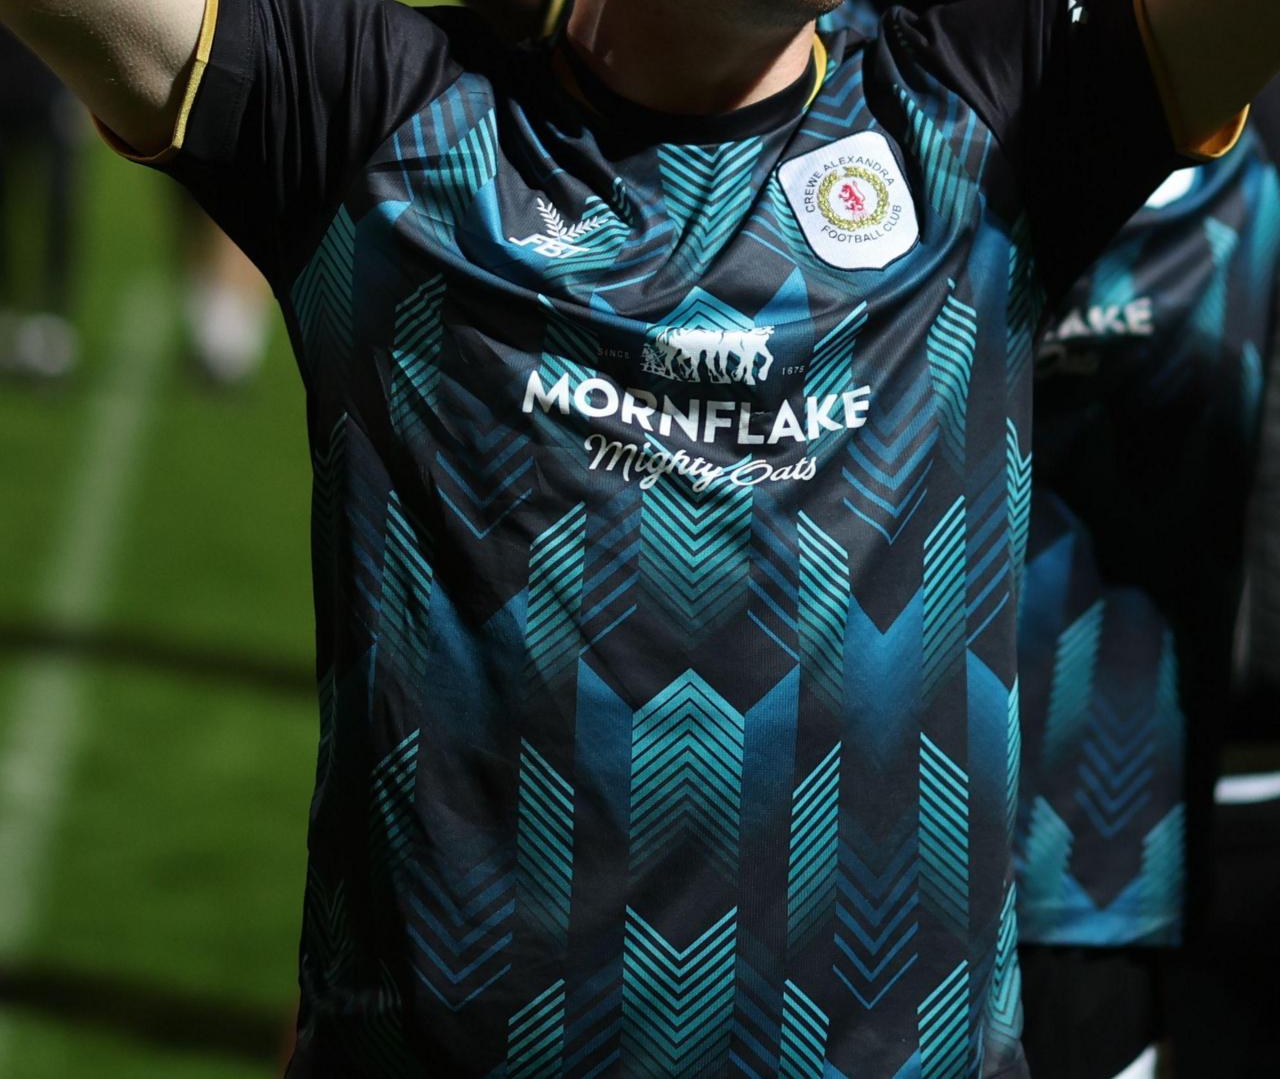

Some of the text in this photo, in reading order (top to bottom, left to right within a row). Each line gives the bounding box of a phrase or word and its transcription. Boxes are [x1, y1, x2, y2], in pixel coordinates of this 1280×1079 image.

[803, 155, 895, 213] CREWE ALEXANDRA
[821, 203, 902, 244] FOOTBALL CLUB
[1044, 296, 1153, 340] AKE
[522, 370, 871, 445] MORNFLAKE
[584, 433, 817, 493] Mighty Oats
